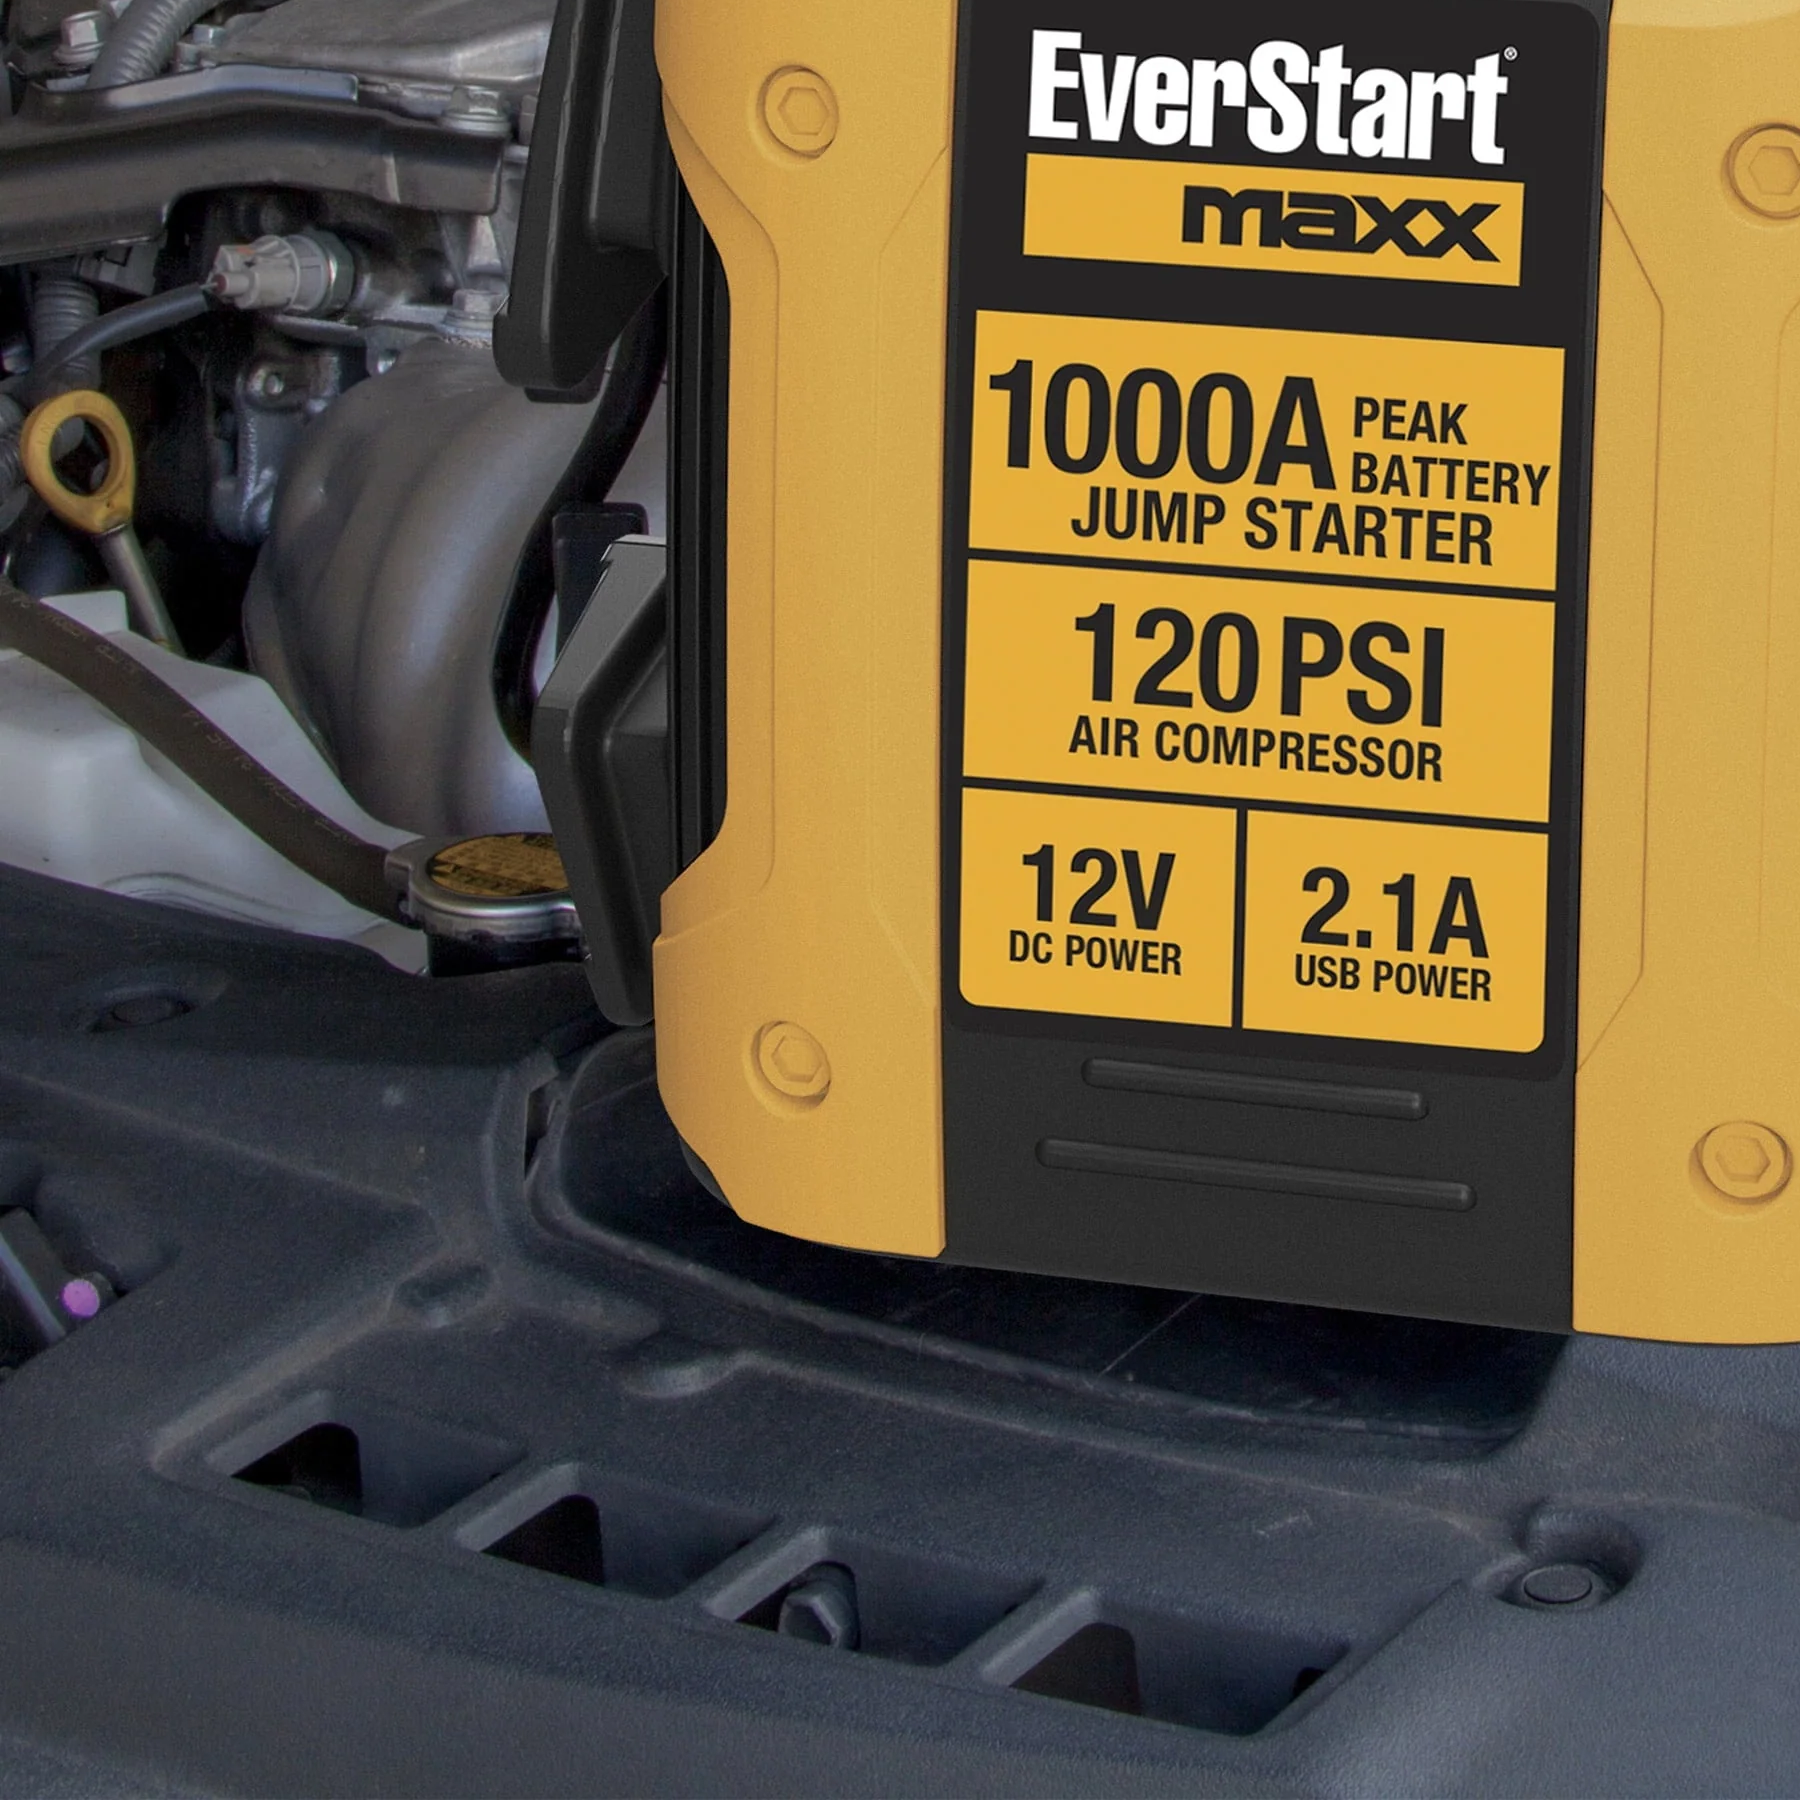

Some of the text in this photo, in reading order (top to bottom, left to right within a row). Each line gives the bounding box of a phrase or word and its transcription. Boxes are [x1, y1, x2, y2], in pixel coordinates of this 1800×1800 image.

[1181, 184, 1502, 263] maxx
[988, 358, 1337, 491] 1000A
[1353, 396, 1469, 445] PEAK
[1350, 452, 1552, 507] BATTERY
[1069, 485, 1493, 567] JUMP STARTER
[1074, 601, 1446, 728] 120 PSI
[1068, 714, 1443, 783] AIR COMPRESSOR
[1021, 843, 1177, 931] 12V
[1300, 866, 1490, 959] 2.1A
[1008, 929, 1182, 976] DC POWER
[1294, 953, 1492, 1003] USB POWER
